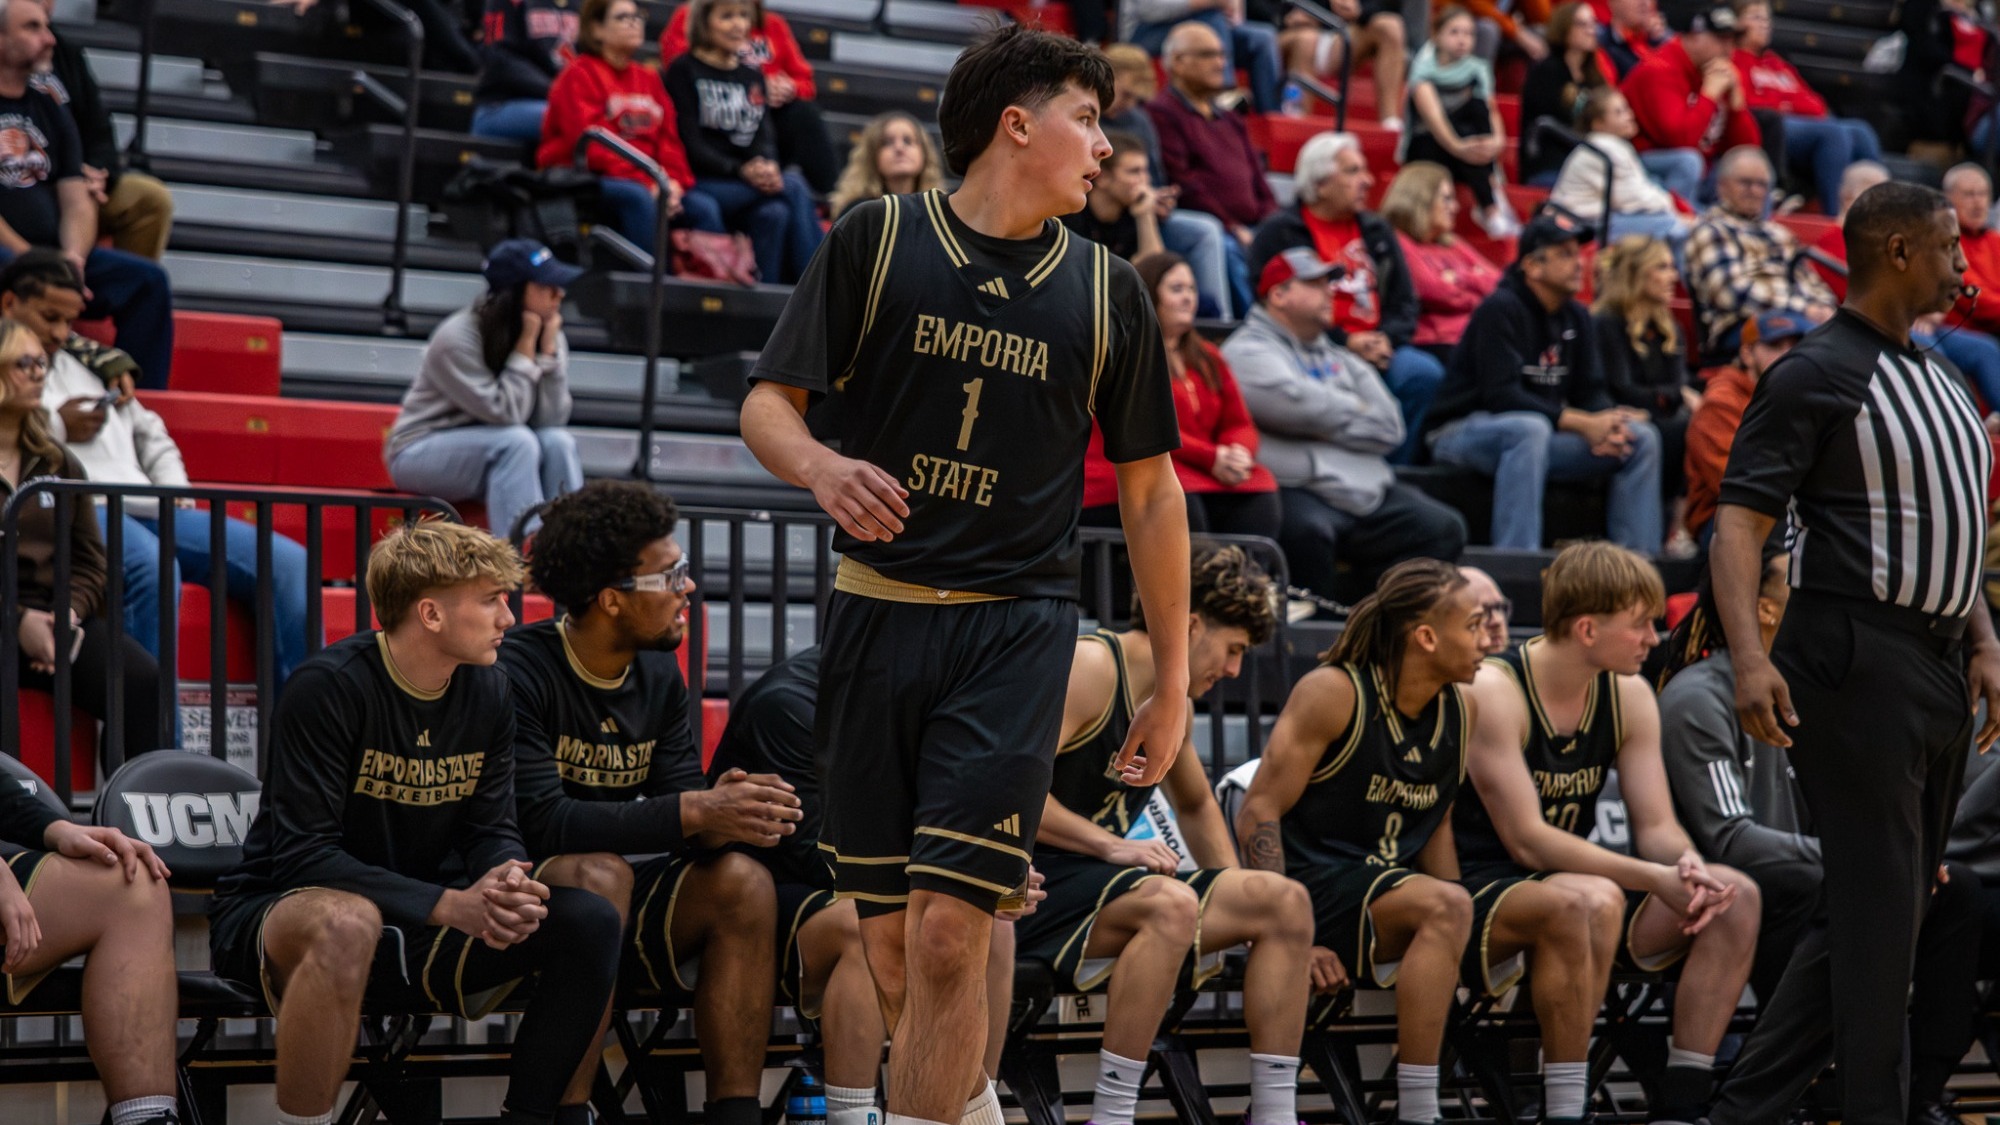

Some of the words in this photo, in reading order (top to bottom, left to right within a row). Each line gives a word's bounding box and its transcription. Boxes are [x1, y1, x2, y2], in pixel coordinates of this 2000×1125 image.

[913, 314, 1048, 381] EMPORIA
[956, 377, 984, 451] 1
[907, 453, 999, 507] STATE
[555, 734, 625, 770] MPORIA
[121, 791, 262, 848] UCM
